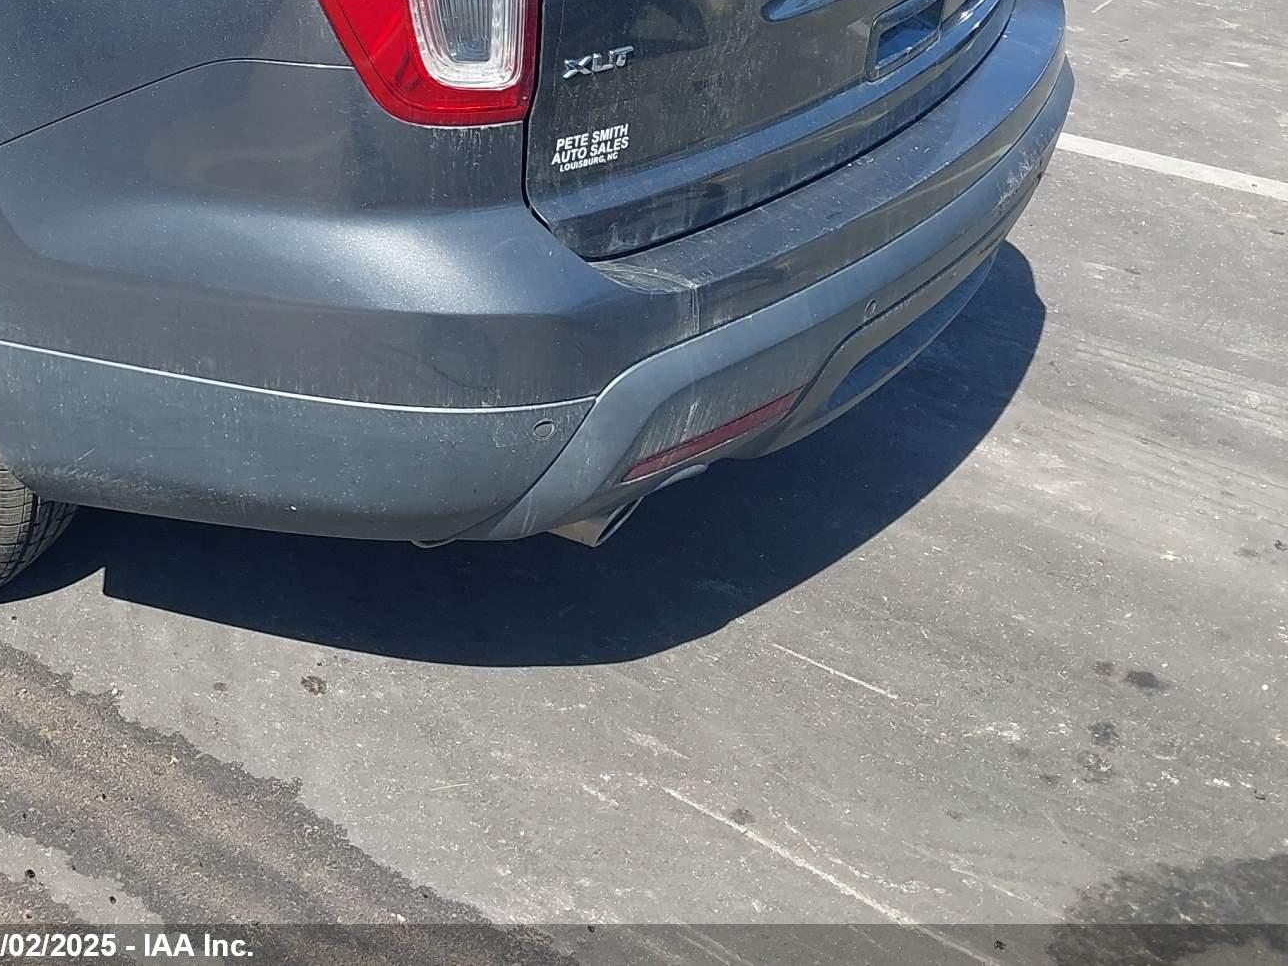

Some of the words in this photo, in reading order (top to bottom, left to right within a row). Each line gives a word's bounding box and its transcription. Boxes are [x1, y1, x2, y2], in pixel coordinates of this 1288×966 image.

[563, 45, 634, 79] XLT
[551, 147, 587, 165] AUTO
[590, 136, 629, 156] SALES
[556, 133, 589, 151] PETE
[592, 123, 629, 143] SMITH
[559, 155, 606, 172] LOUISBURG,
[607, 152, 618, 161] NC
